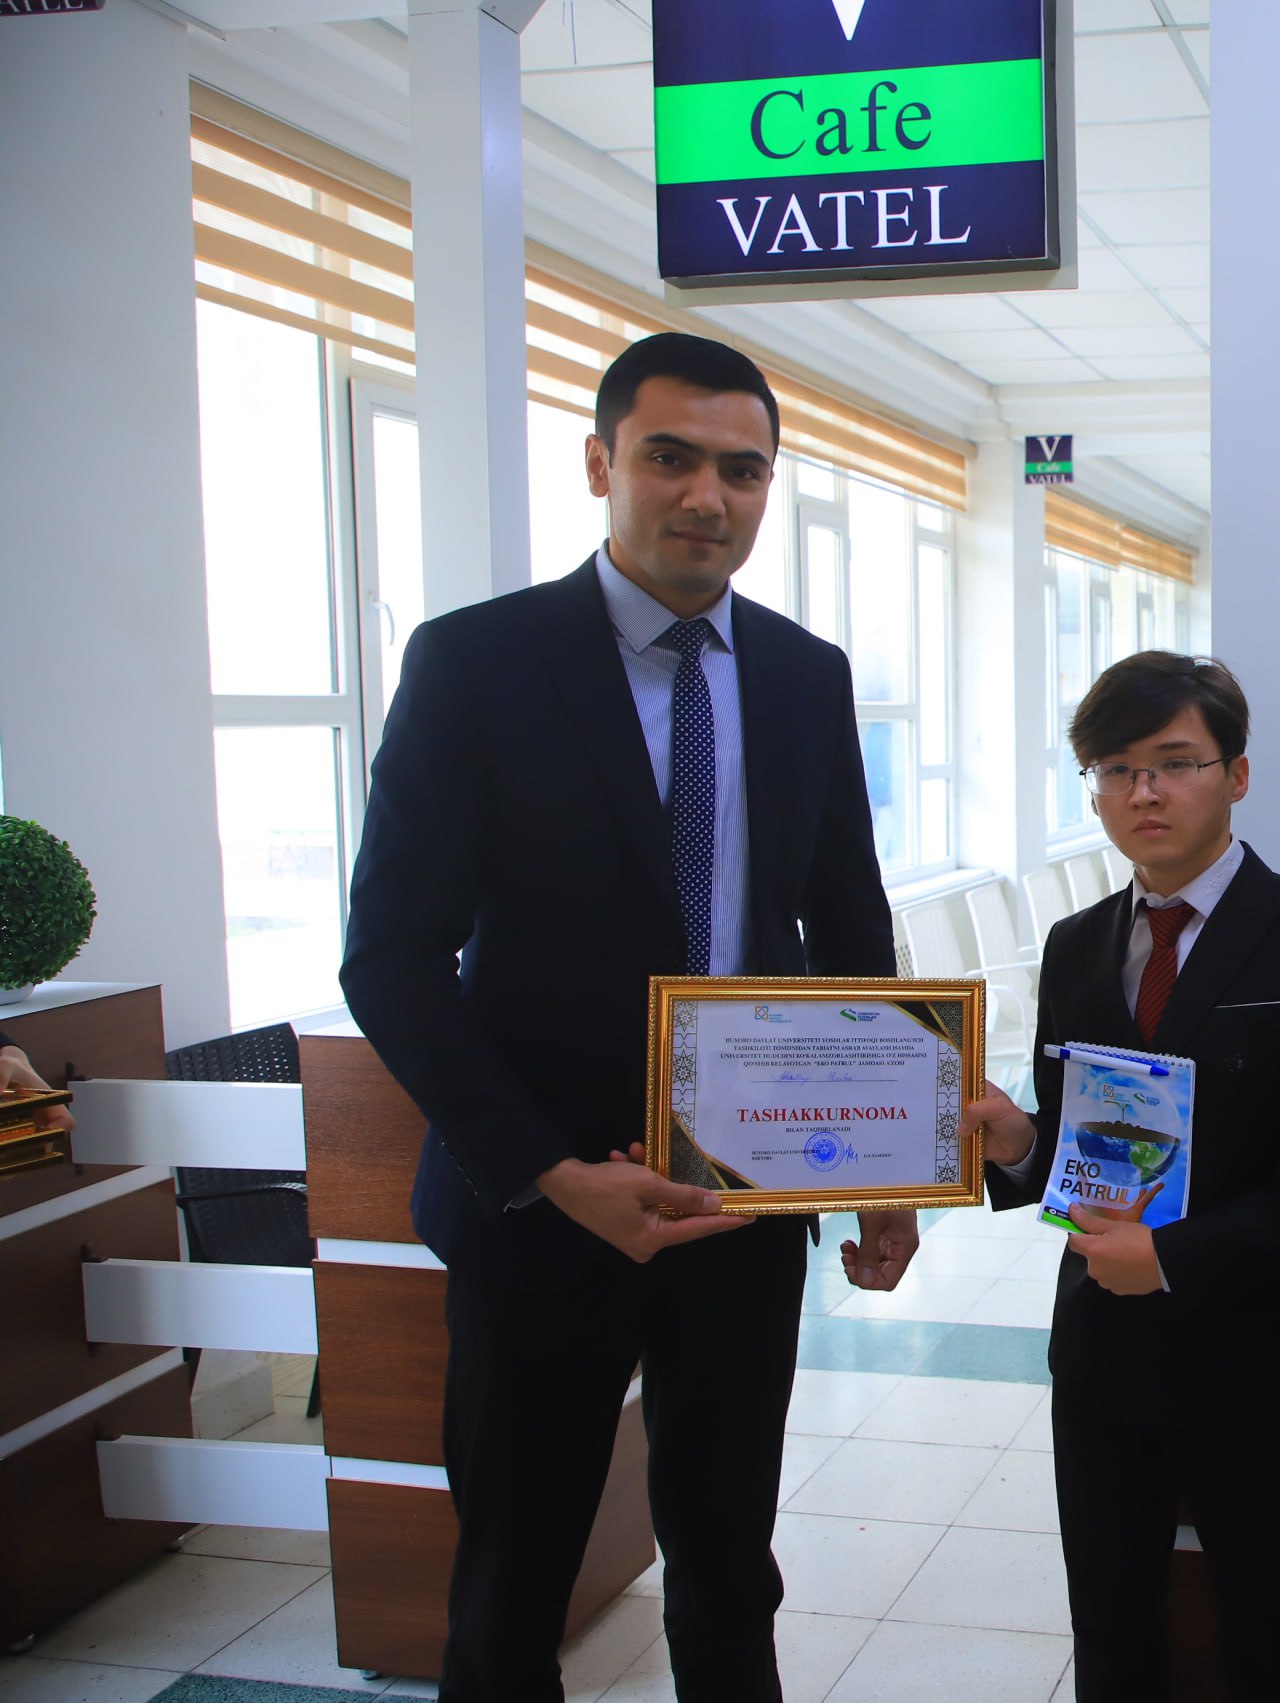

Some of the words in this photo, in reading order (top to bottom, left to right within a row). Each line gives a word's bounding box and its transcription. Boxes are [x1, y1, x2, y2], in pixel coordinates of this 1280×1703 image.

[751, 80, 932, 160] Cafe
[716, 185, 972, 257] VATEL
[1037, 436, 1061, 461] V
[737, 1106, 908, 1123] TASHAKKURNOMA
[1064, 1158, 1102, 1179] EKO
[1059, 1178, 1130, 1205] PATRUL
